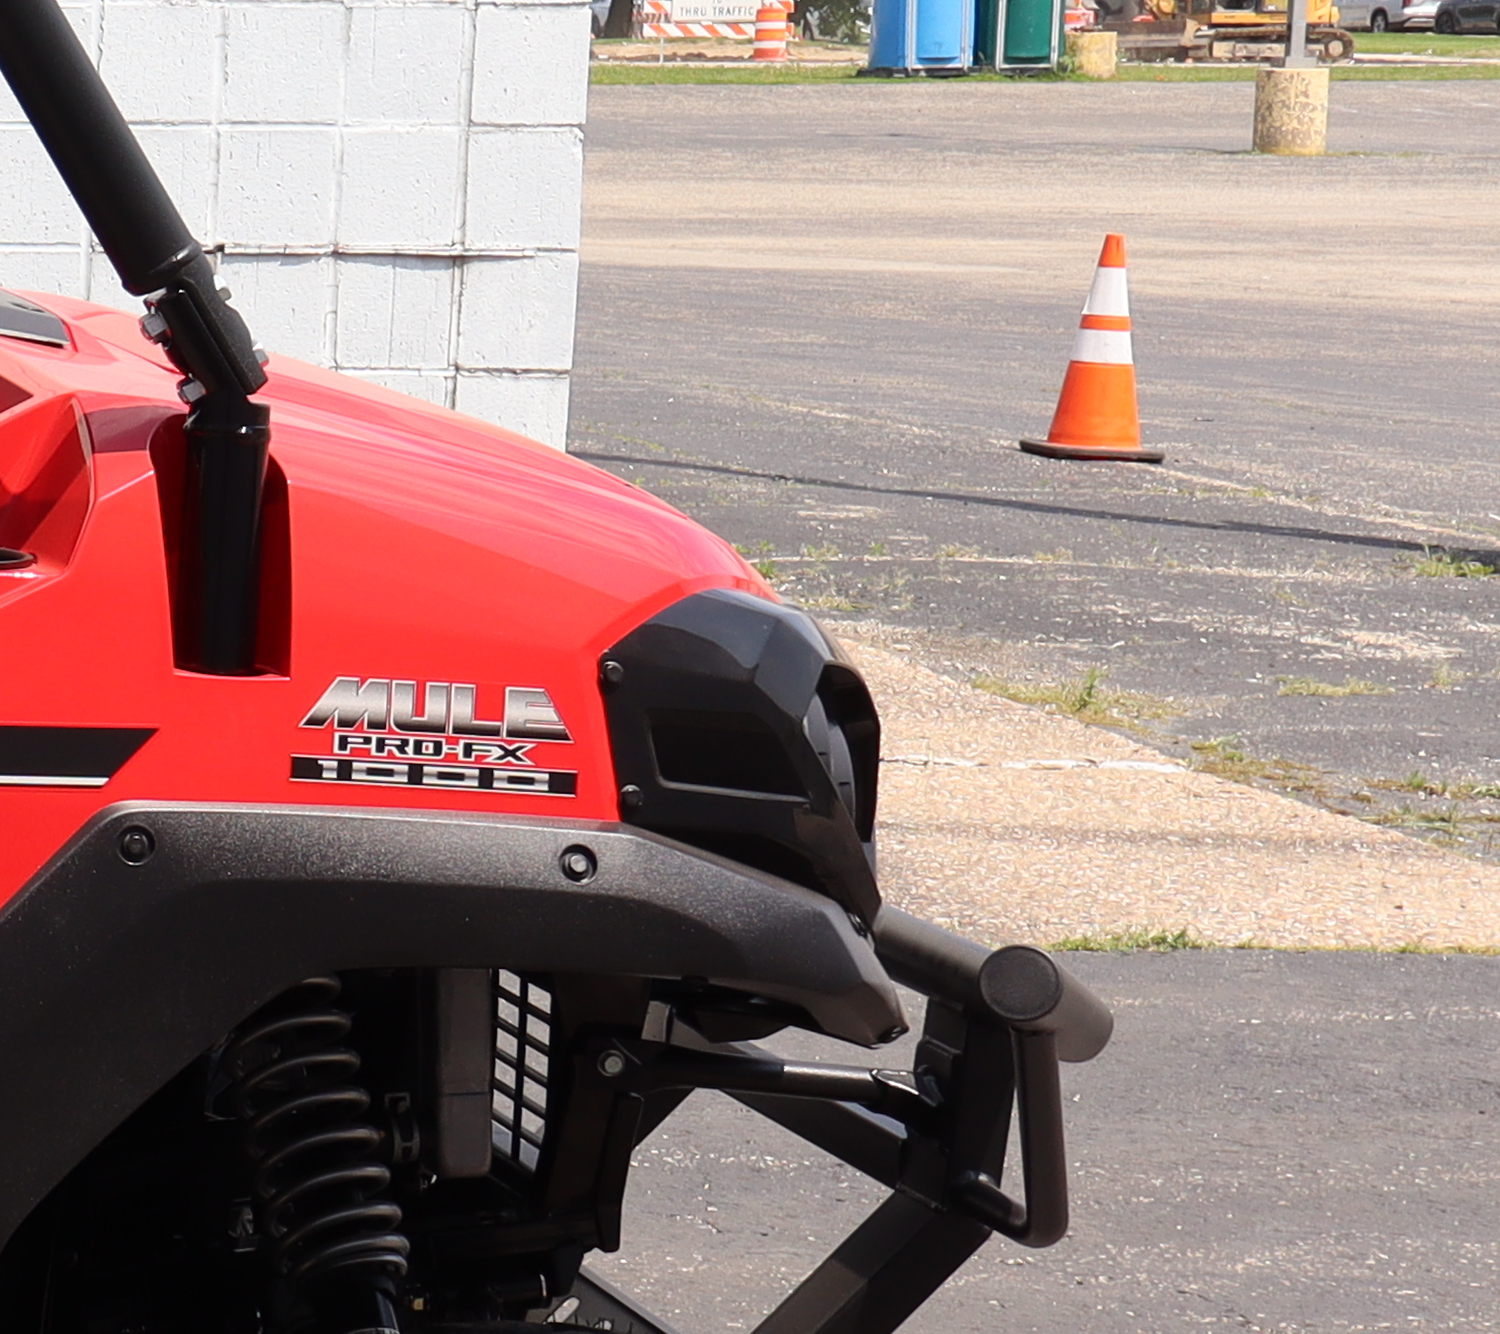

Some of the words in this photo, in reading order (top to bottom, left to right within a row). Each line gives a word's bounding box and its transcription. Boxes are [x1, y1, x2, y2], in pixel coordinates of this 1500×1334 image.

[680, 6, 707, 17] THRU
[712, 6, 755, 17] TRAFFIC
[298, 676, 574, 743] MULE
[333, 731, 537, 766] PRO-FX
[317, 759, 550, 792] 1000
